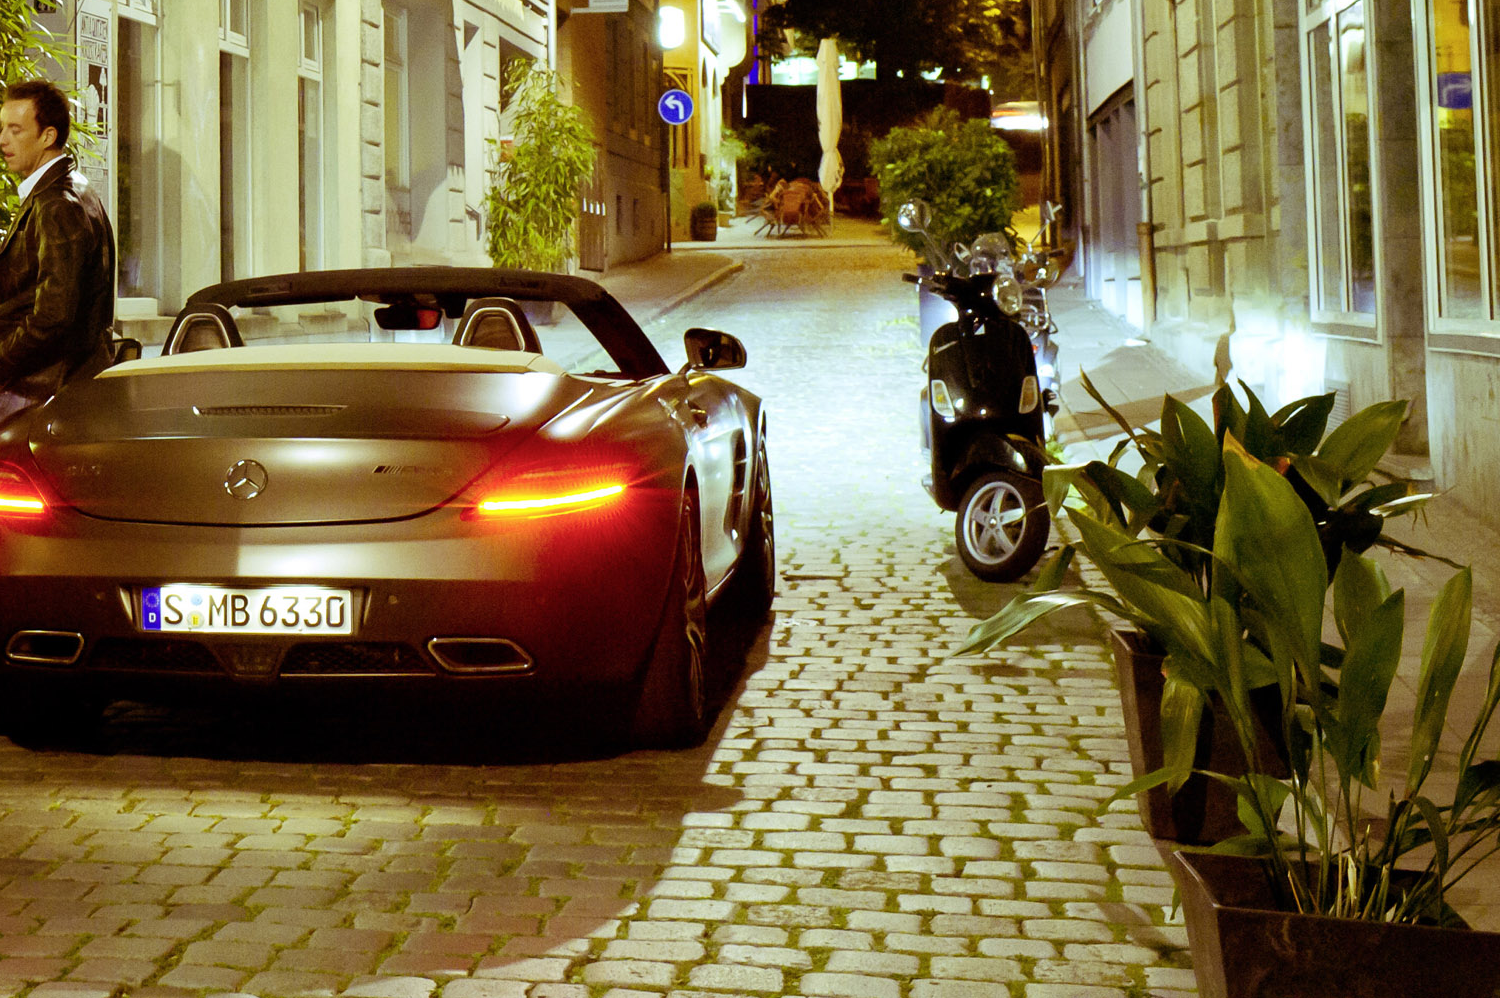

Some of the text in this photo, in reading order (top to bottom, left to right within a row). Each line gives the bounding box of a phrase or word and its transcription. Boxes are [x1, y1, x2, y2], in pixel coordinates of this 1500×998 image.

[148, 612, 157, 623] D
[164, 593, 346, 628] S MB 6330
